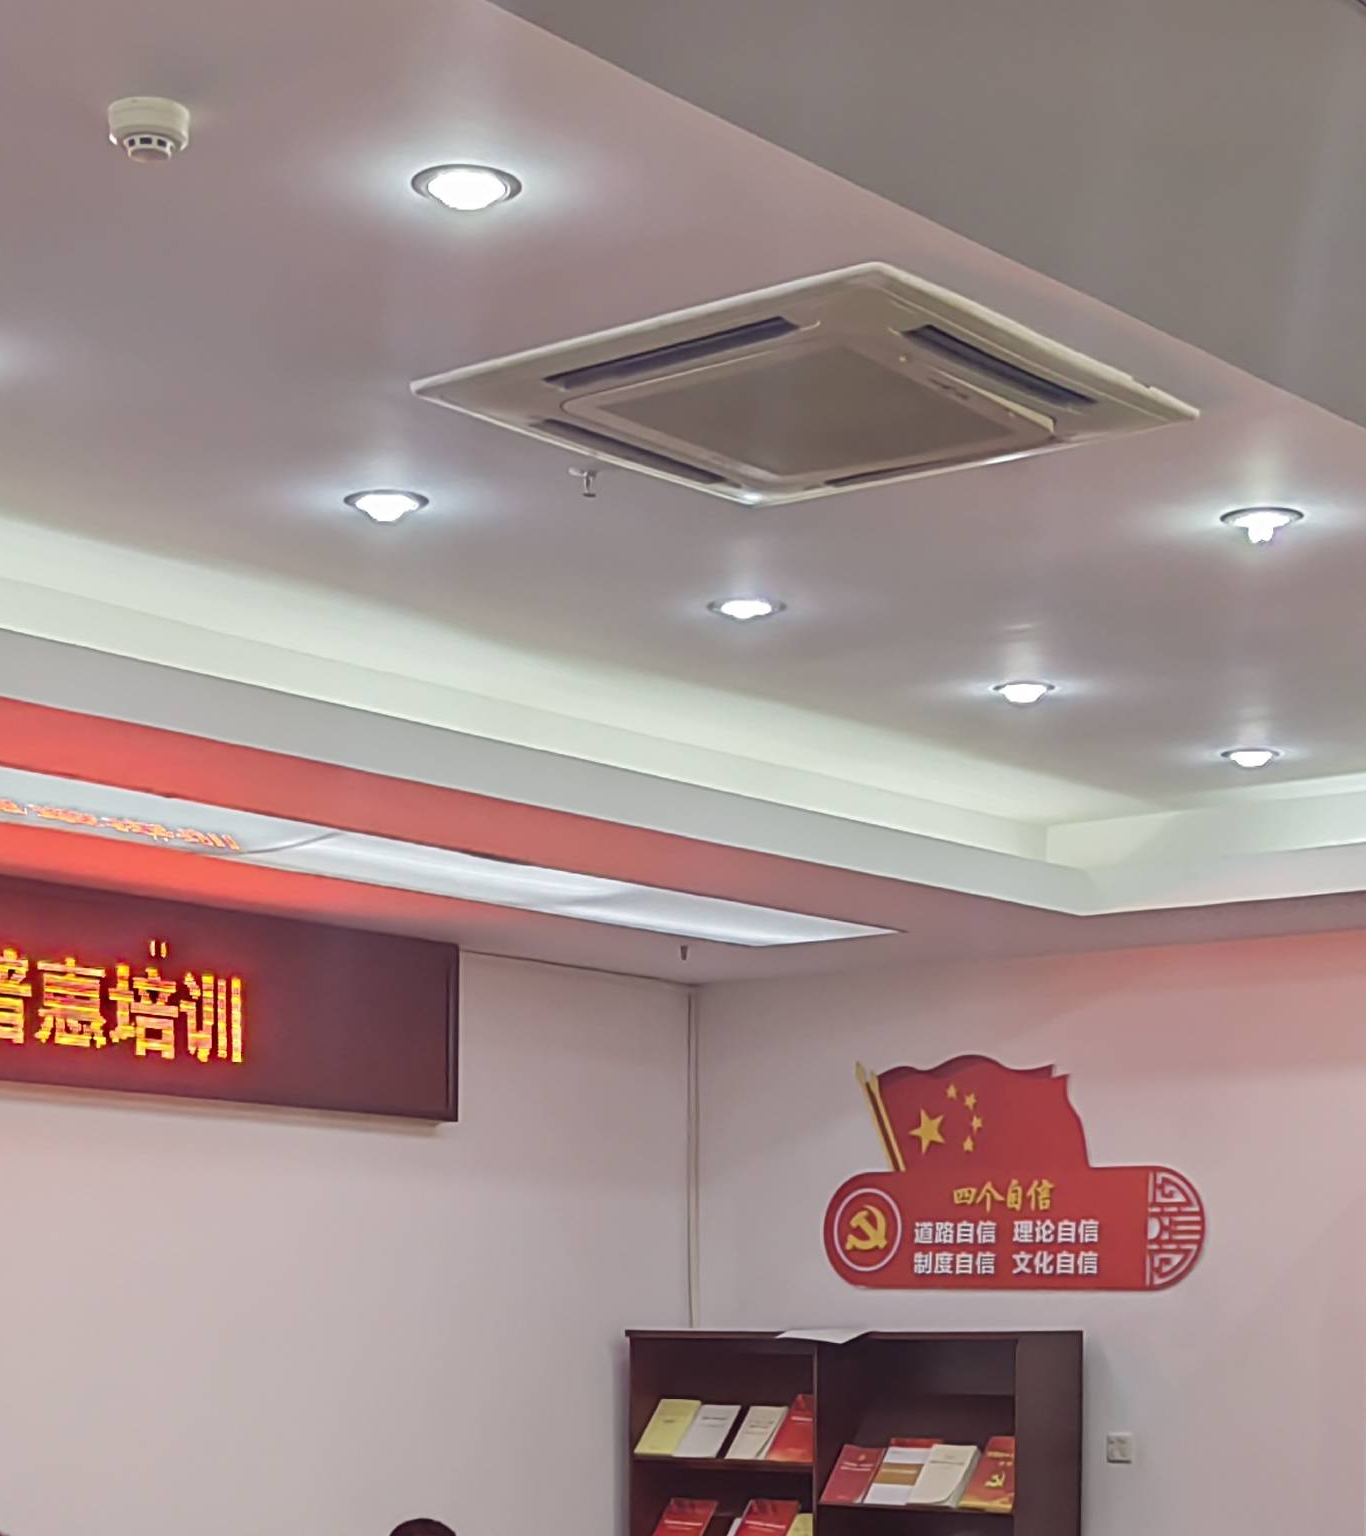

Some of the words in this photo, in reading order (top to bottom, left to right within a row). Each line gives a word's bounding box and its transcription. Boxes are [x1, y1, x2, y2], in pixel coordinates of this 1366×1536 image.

[952, 1179, 1055, 1213] 四个自信
[913, 1220, 996, 1246] 道路自信
[1012, 1219, 1100, 1245] 理论自信
[913, 1251, 996, 1276] 制度自信
[1011, 1250, 1099, 1276] 文化自信
